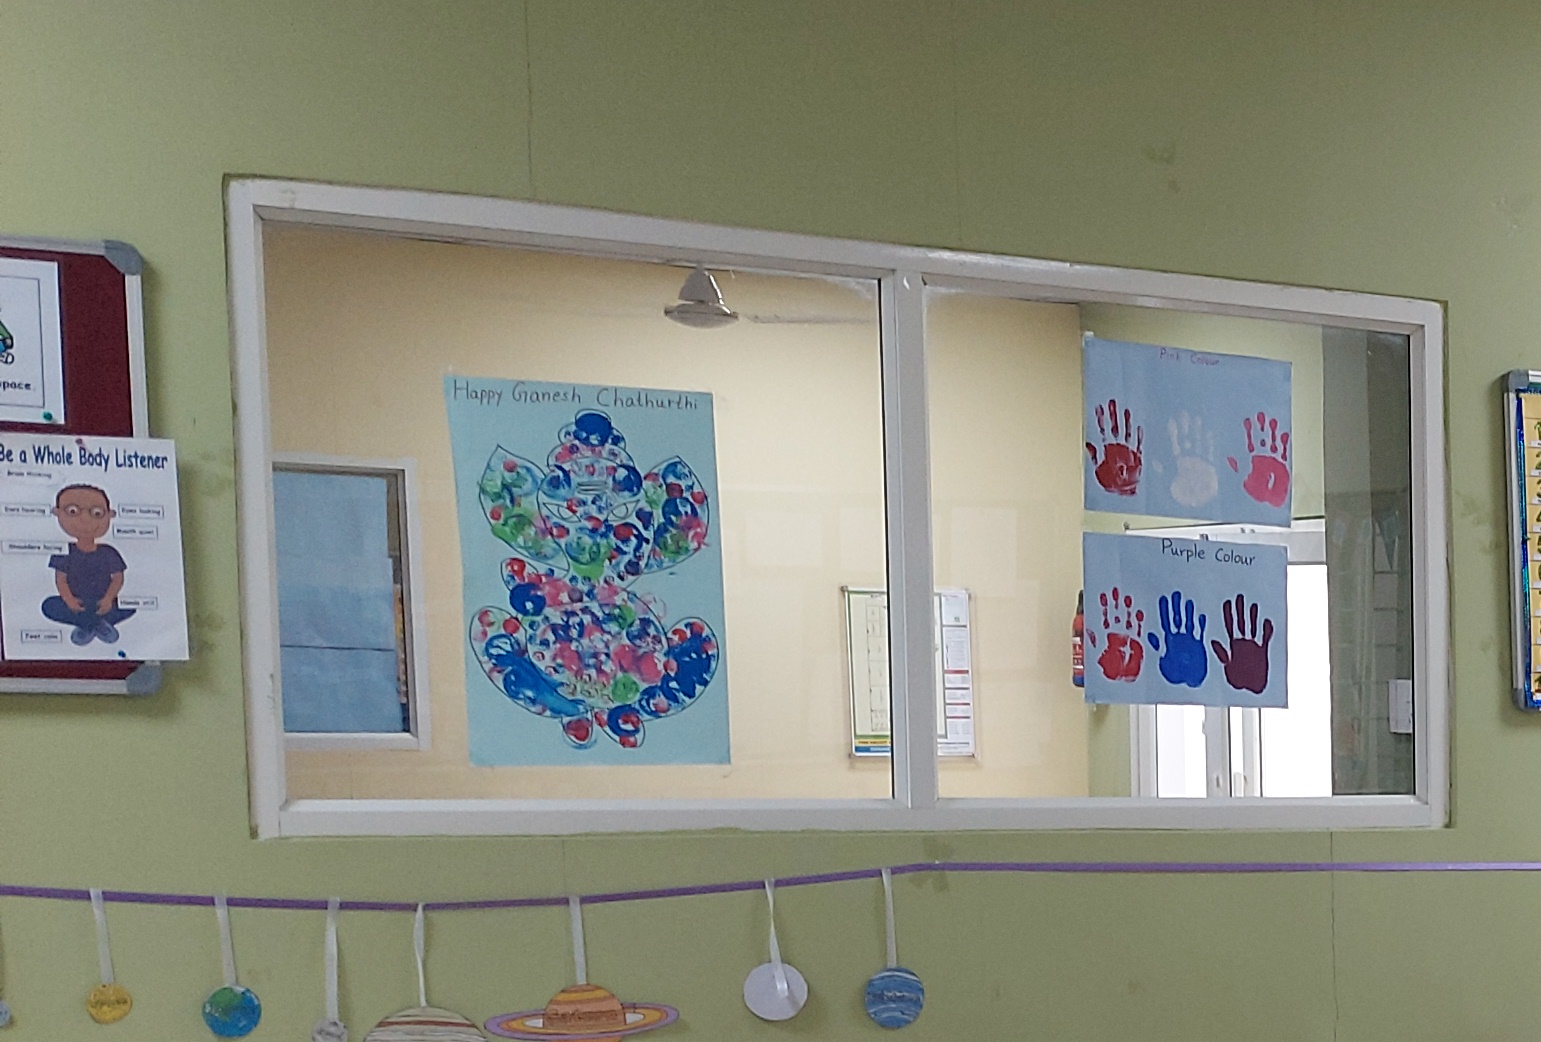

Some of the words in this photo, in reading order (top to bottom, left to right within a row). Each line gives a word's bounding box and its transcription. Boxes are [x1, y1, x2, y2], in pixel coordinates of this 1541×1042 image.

[0, 381, 36, 392] pace.
[453, 379, 502, 407] Happy
[512, 381, 581, 404] Ganesh
[596, 387, 698, 410] Chathurthi
[0, 443, 14, 463] Be
[19, 452, 27, 464] a
[32, 444, 74, 466] Whole
[79, 447, 110, 472] Body
[115, 448, 168, 470] Listener
[1161, 538, 1206, 563] Purple
[1215, 548, 1256, 566] Colour
